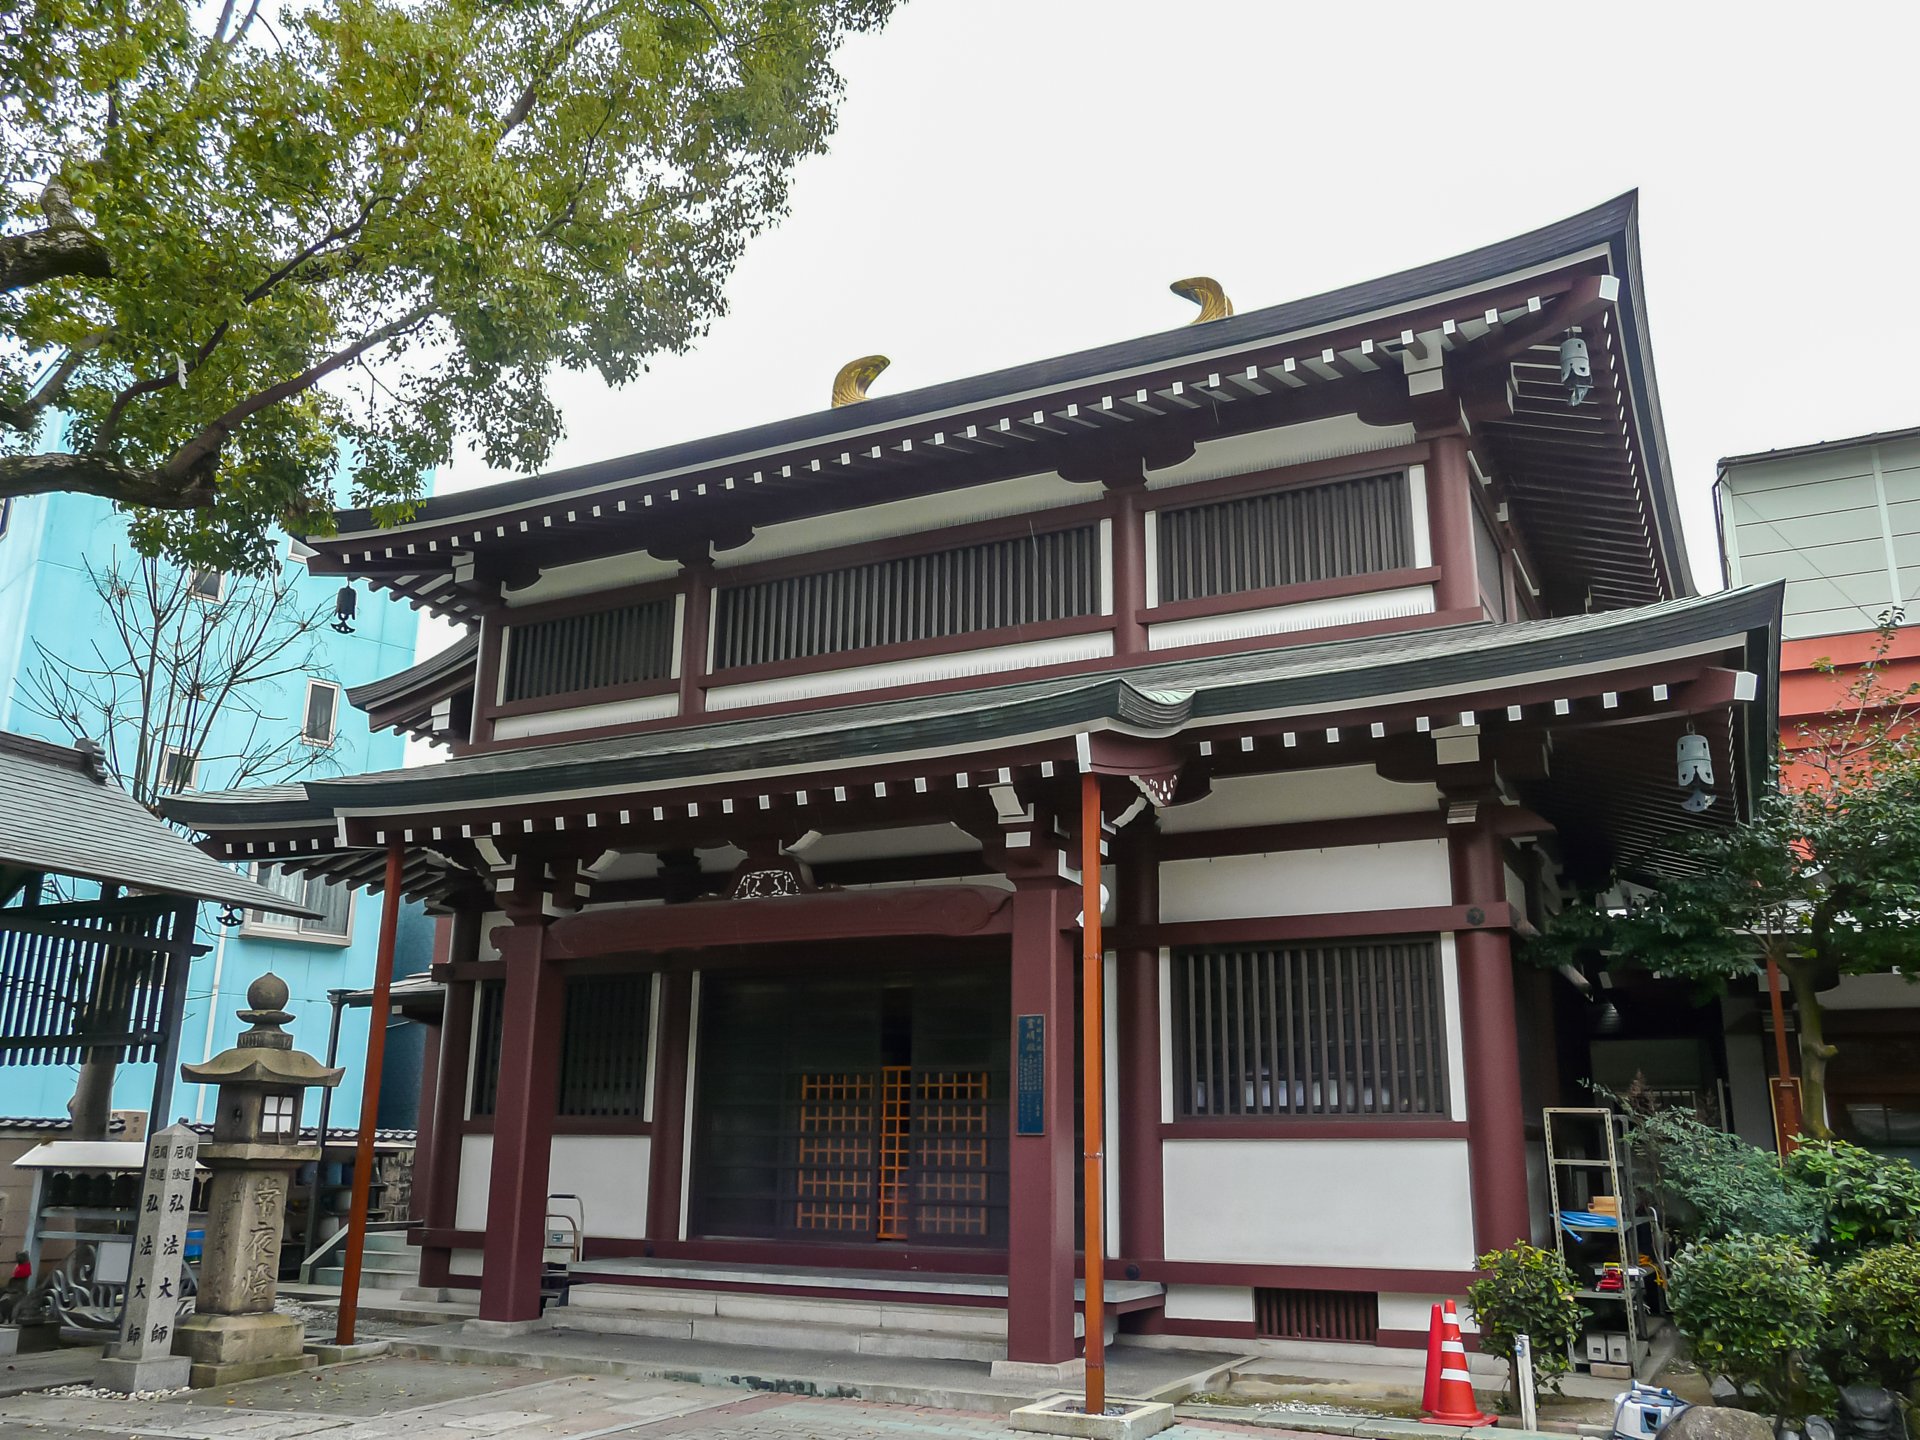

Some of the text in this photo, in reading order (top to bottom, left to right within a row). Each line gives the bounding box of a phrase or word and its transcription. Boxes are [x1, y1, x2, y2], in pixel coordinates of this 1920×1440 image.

[127, 1194, 158, 1346] 弘法大師
[151, 1194, 185, 1344] 弘法大師
[242, 1176, 281, 1303] 常夜燈
